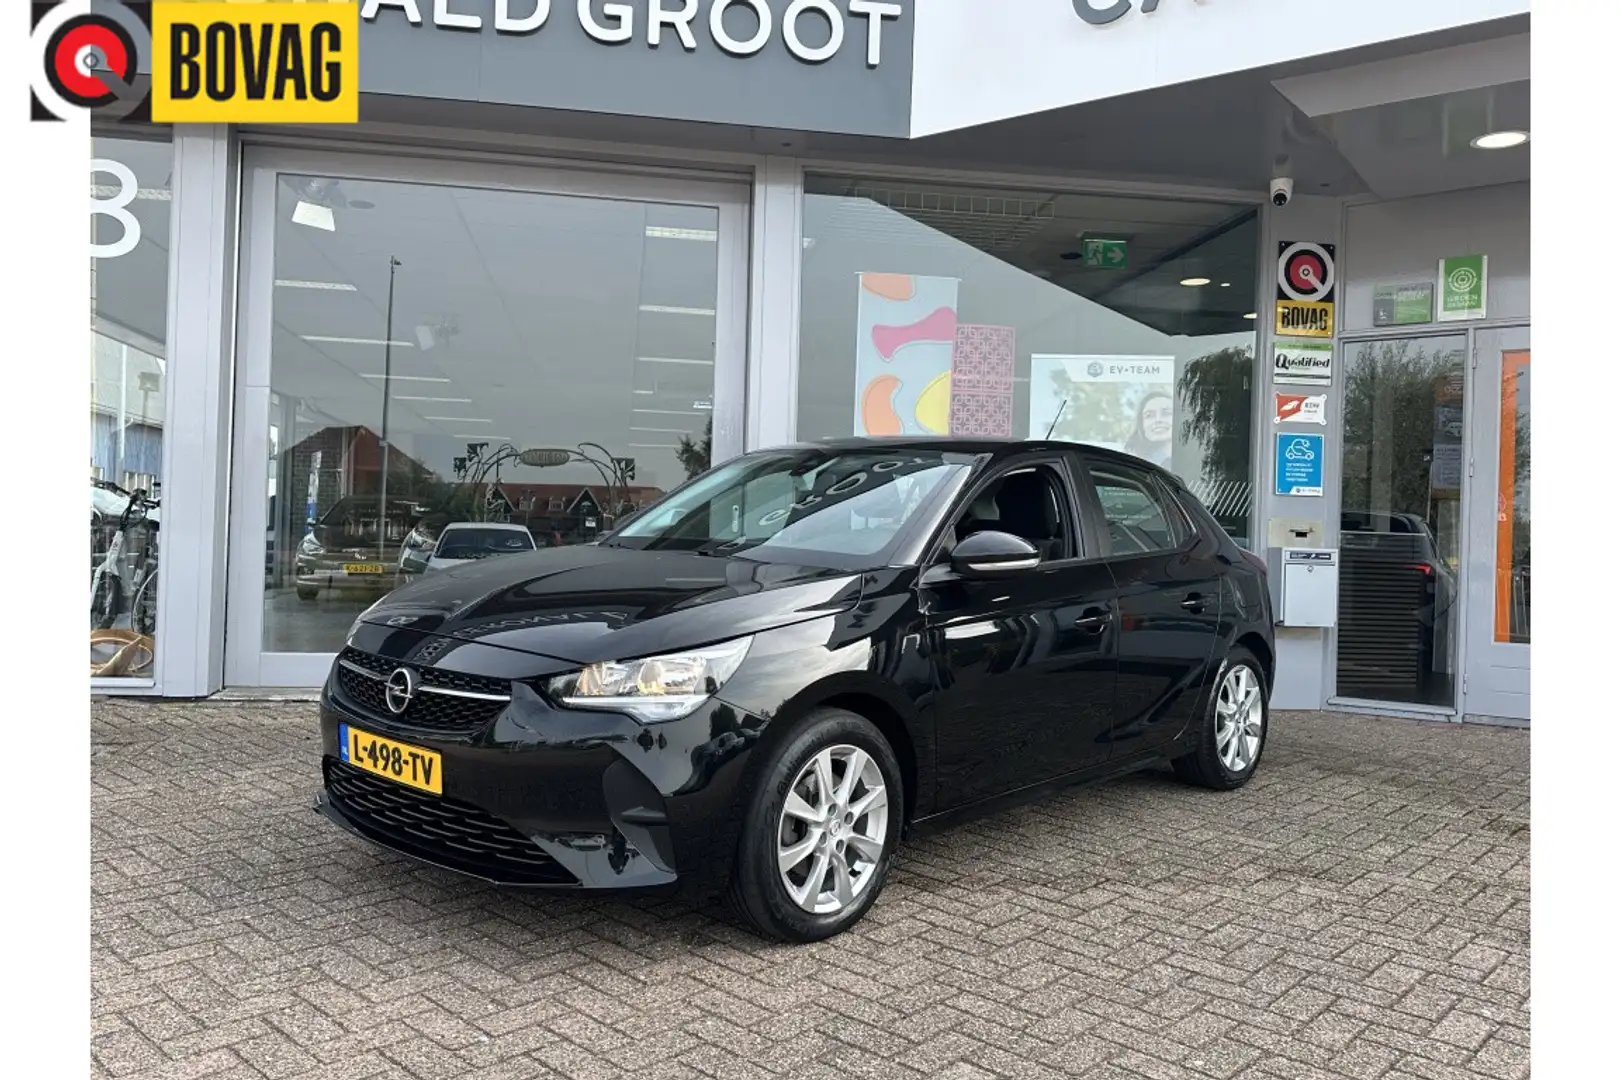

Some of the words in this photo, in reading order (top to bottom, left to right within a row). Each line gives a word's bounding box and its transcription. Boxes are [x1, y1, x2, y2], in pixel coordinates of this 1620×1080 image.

[577, 0, 902, 66] GROOT
[1282, 306, 1329, 331] BOVAG
[1275, 353, 1331, 370] Qualified
[352, 733, 434, 786] L-498-TV
